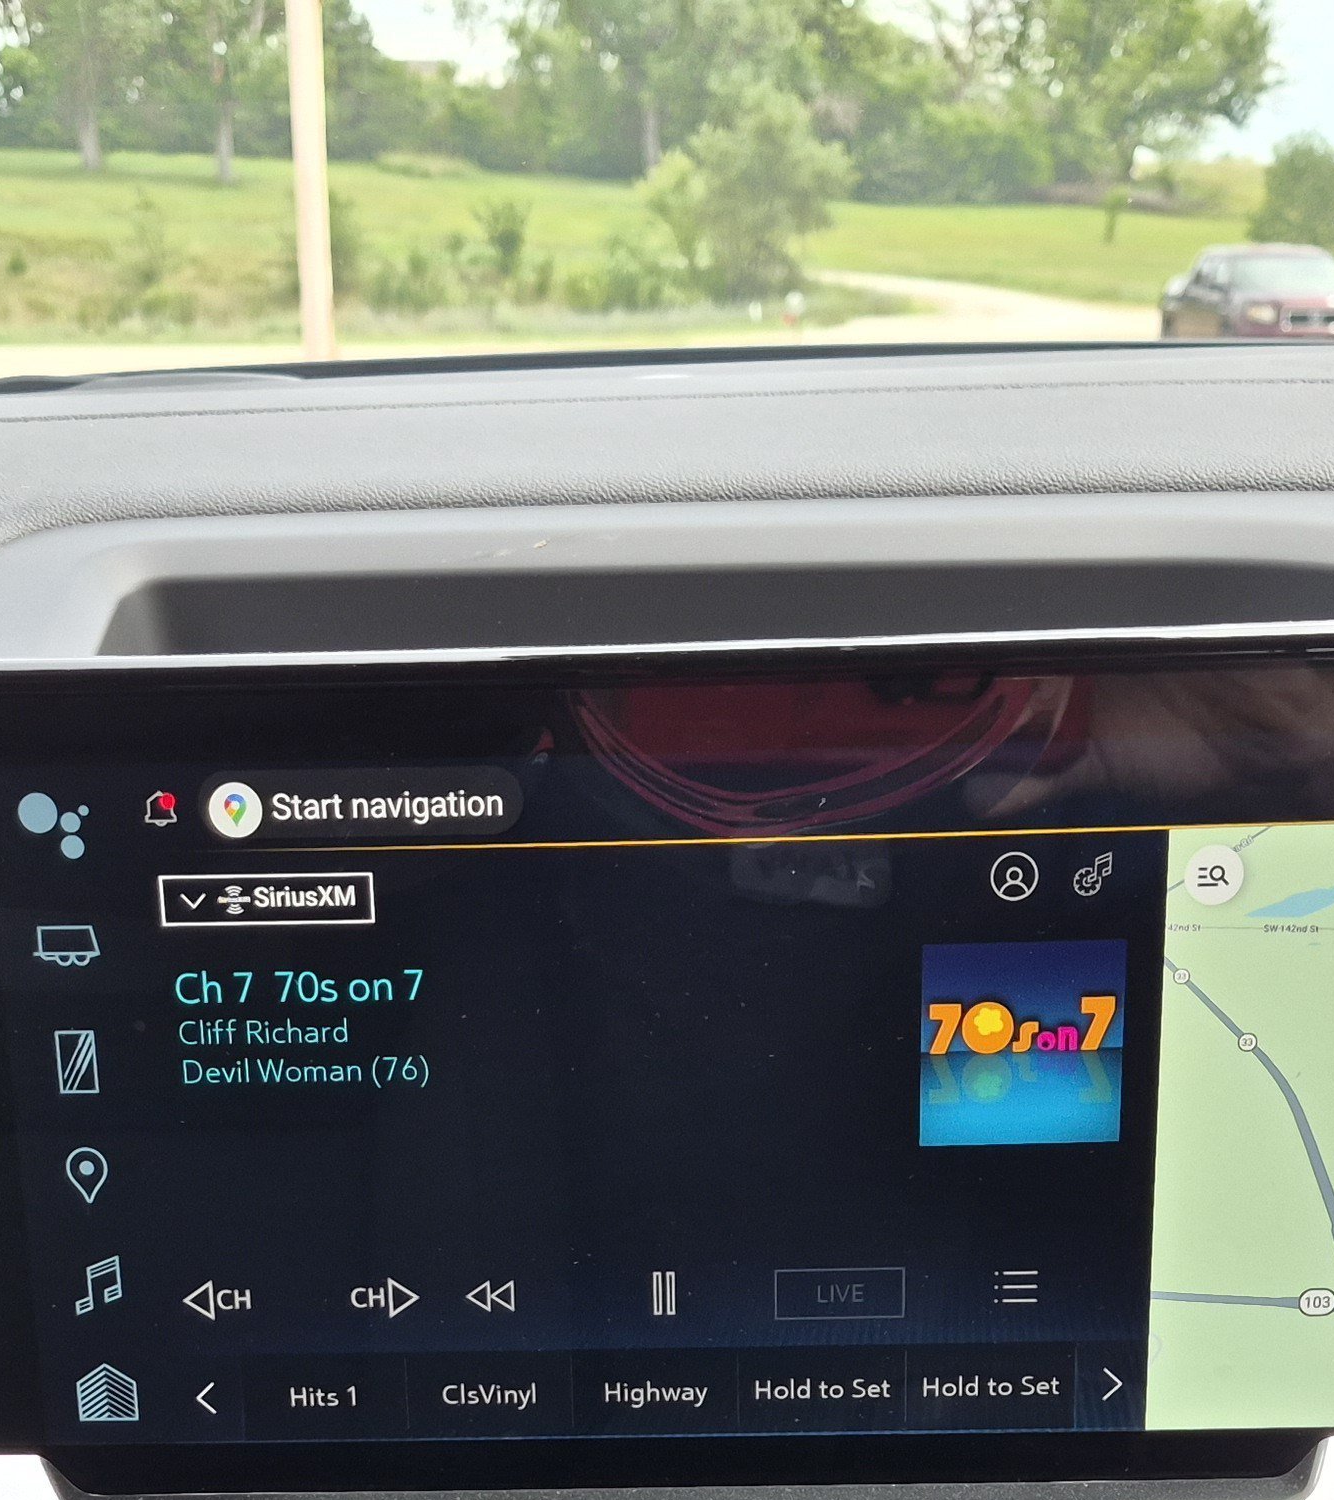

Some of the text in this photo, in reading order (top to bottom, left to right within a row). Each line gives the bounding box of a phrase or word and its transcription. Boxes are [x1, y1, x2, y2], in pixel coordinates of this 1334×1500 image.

[271, 789, 504, 825] Start navigation
[252, 884, 357, 908] SiriusXM
[1264, 924, 1280, 933] SW
[1281, 923, 1308, 934] 142nd
[174, 969, 424, 1005] Ch 7 70s on 7
[178, 1019, 348, 1046] Cliff Richard
[929, 995, 1117, 1055] 70s on 7
[182, 1055, 430, 1088] Devil Woman (76)
[217, 1289, 252, 1311] CH
[350, 1287, 386, 1309] CH
[816, 1283, 865, 1304] LIVE
[1303, 1296, 1331, 1309] 103
[289, 1386, 358, 1408] Hits 1
[442, 1382, 537, 1410] ClsVinyl
[604, 1381, 708, 1408] Highway
[754, 1378, 892, 1400] Hold to Set
[922, 1375, 1060, 1398] Hold to Set
